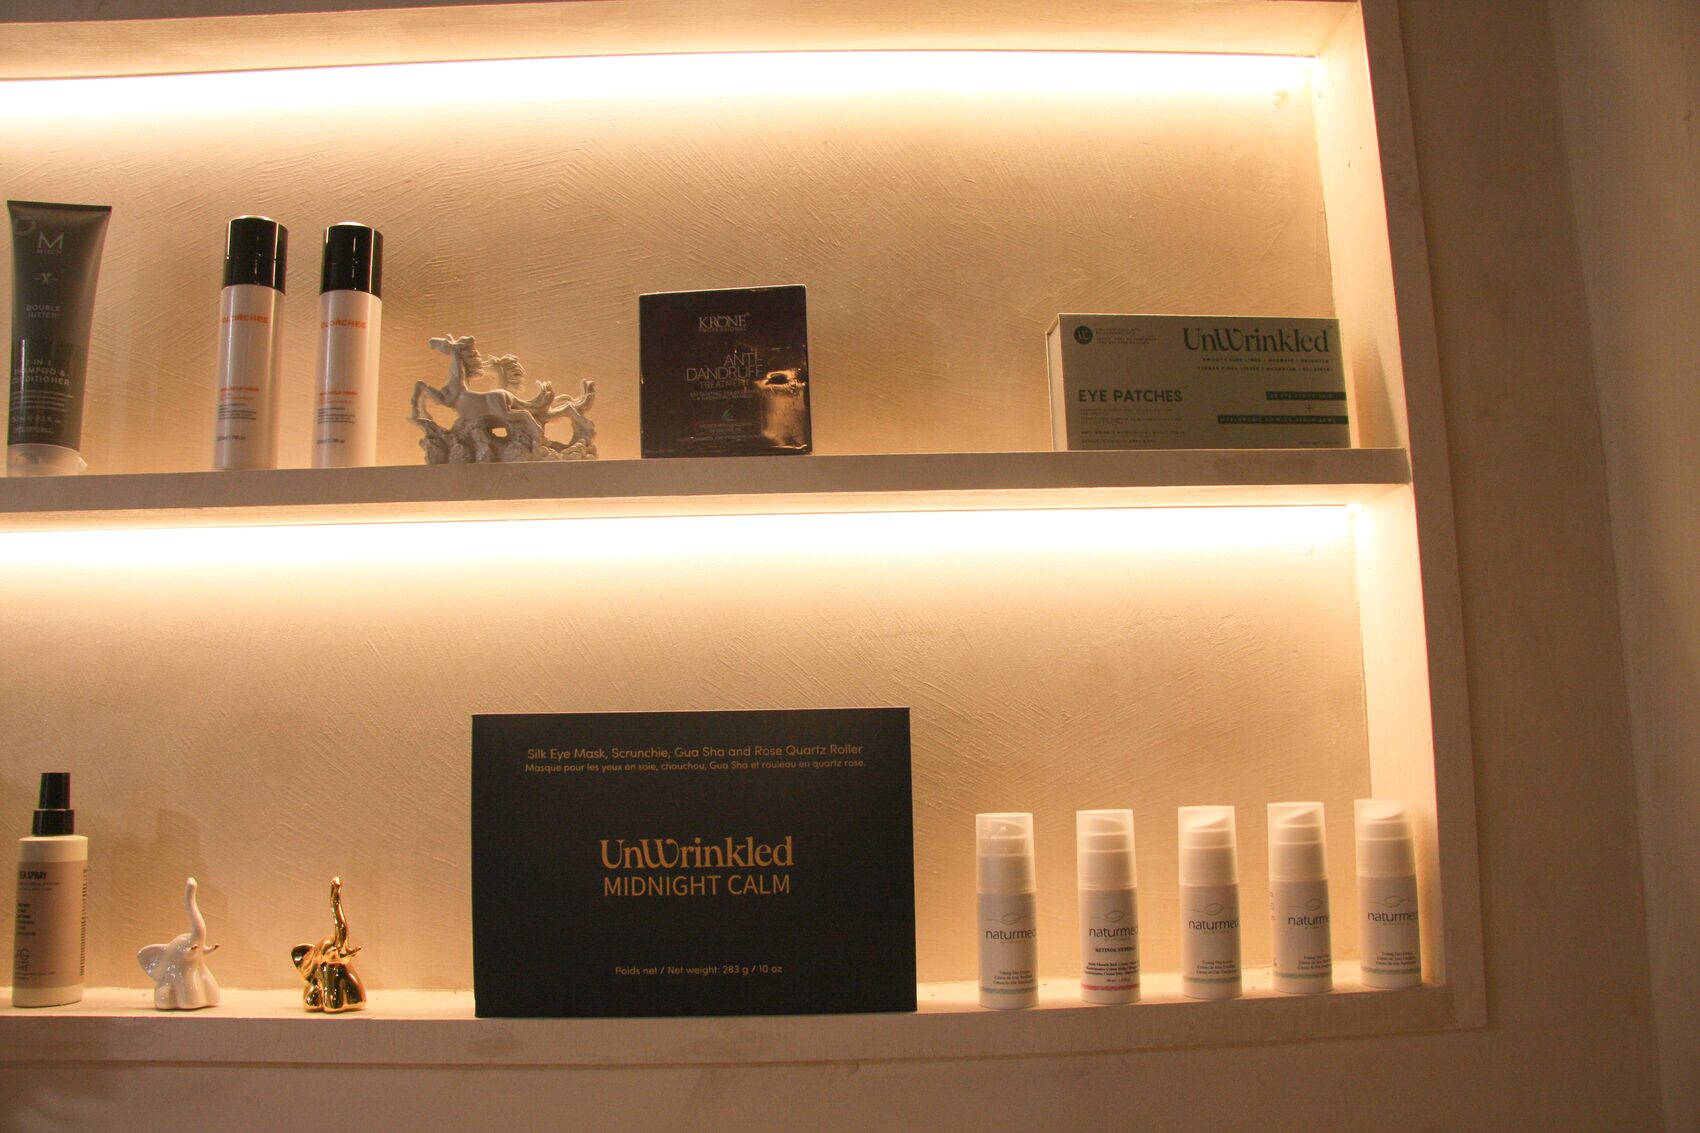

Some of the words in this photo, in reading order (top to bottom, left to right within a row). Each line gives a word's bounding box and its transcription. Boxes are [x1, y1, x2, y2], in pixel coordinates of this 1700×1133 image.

[38, 231, 64, 249] M
[25, 304, 61, 312] DOUBLE
[1182, 327, 1330, 352] UnWrinkled
[723, 352, 764, 366] ANTI-
[686, 365, 763, 381] DANDRUFF
[1079, 389, 1107, 402] EYE
[1113, 389, 1183, 402] PATCHES
[527, 748, 546, 760] Silk
[550, 748, 571, 761] Eye
[574, 747, 609, 760] Mask,
[611, 746, 671, 760] Scrunchie,
[674, 747, 699, 758] Gua
[702, 746, 727, 757] Sha
[728, 746, 752, 757] and
[754, 746, 783, 756] Rose
[785, 745, 826, 756] Quartz
[829, 744, 863, 755] Roller
[525, 764, 562, 773] Masque
[564, 764, 585, 773] pour
[587, 763, 600, 771] les
[602, 764, 622, 773] yeux
[638, 763, 658, 772] soie,
[660, 762, 708, 771] chouchou,
[709, 761, 729, 770] Gua
[731, 761, 748, 769] Sha
[750, 761, 760, 769] et
[762, 761, 797, 769] rouleau
[812, 760, 842, 769] quartz
[600, 835, 795, 869] UnWrinkled
[604, 875, 721, 897] MIDNIGHT
[727, 873, 791, 895] CALM
[615, 966, 641, 975] Poids
[643, 966, 658, 975] net
[668, 966, 684, 975] Net
[686, 966, 722, 976] weight:
[723, 965, 740, 974] 283
[741, 967, 749, 976] g
[759, 964, 769, 974] 10
[771, 966, 784, 974] oz
